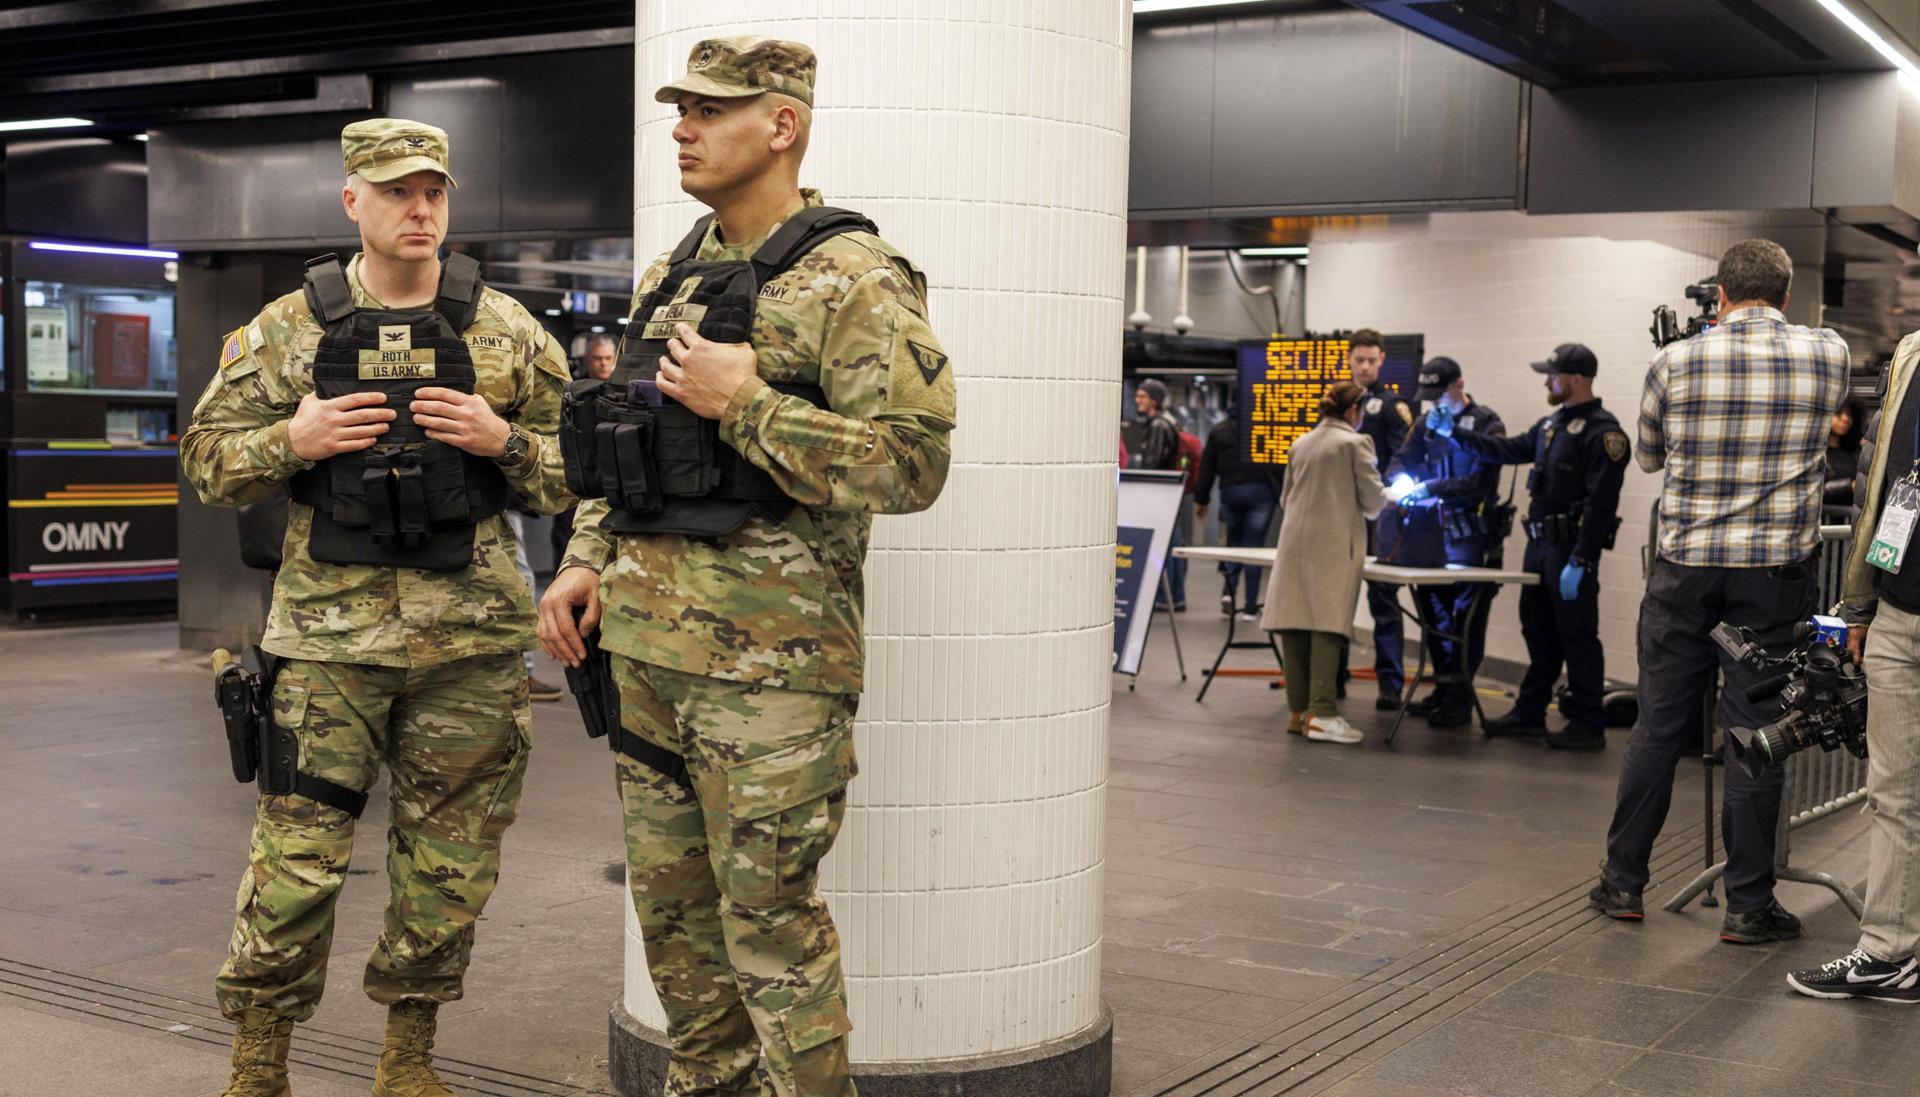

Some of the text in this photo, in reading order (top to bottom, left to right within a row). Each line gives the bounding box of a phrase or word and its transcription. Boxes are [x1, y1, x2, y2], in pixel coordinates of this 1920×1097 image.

[760, 284, 789, 299] RMY
[472, 336, 504, 348] ARMY
[382, 351, 411, 362] ROTH
[1265, 340, 1353, 380] SECURI
[42, 521, 130, 553] OMNY
